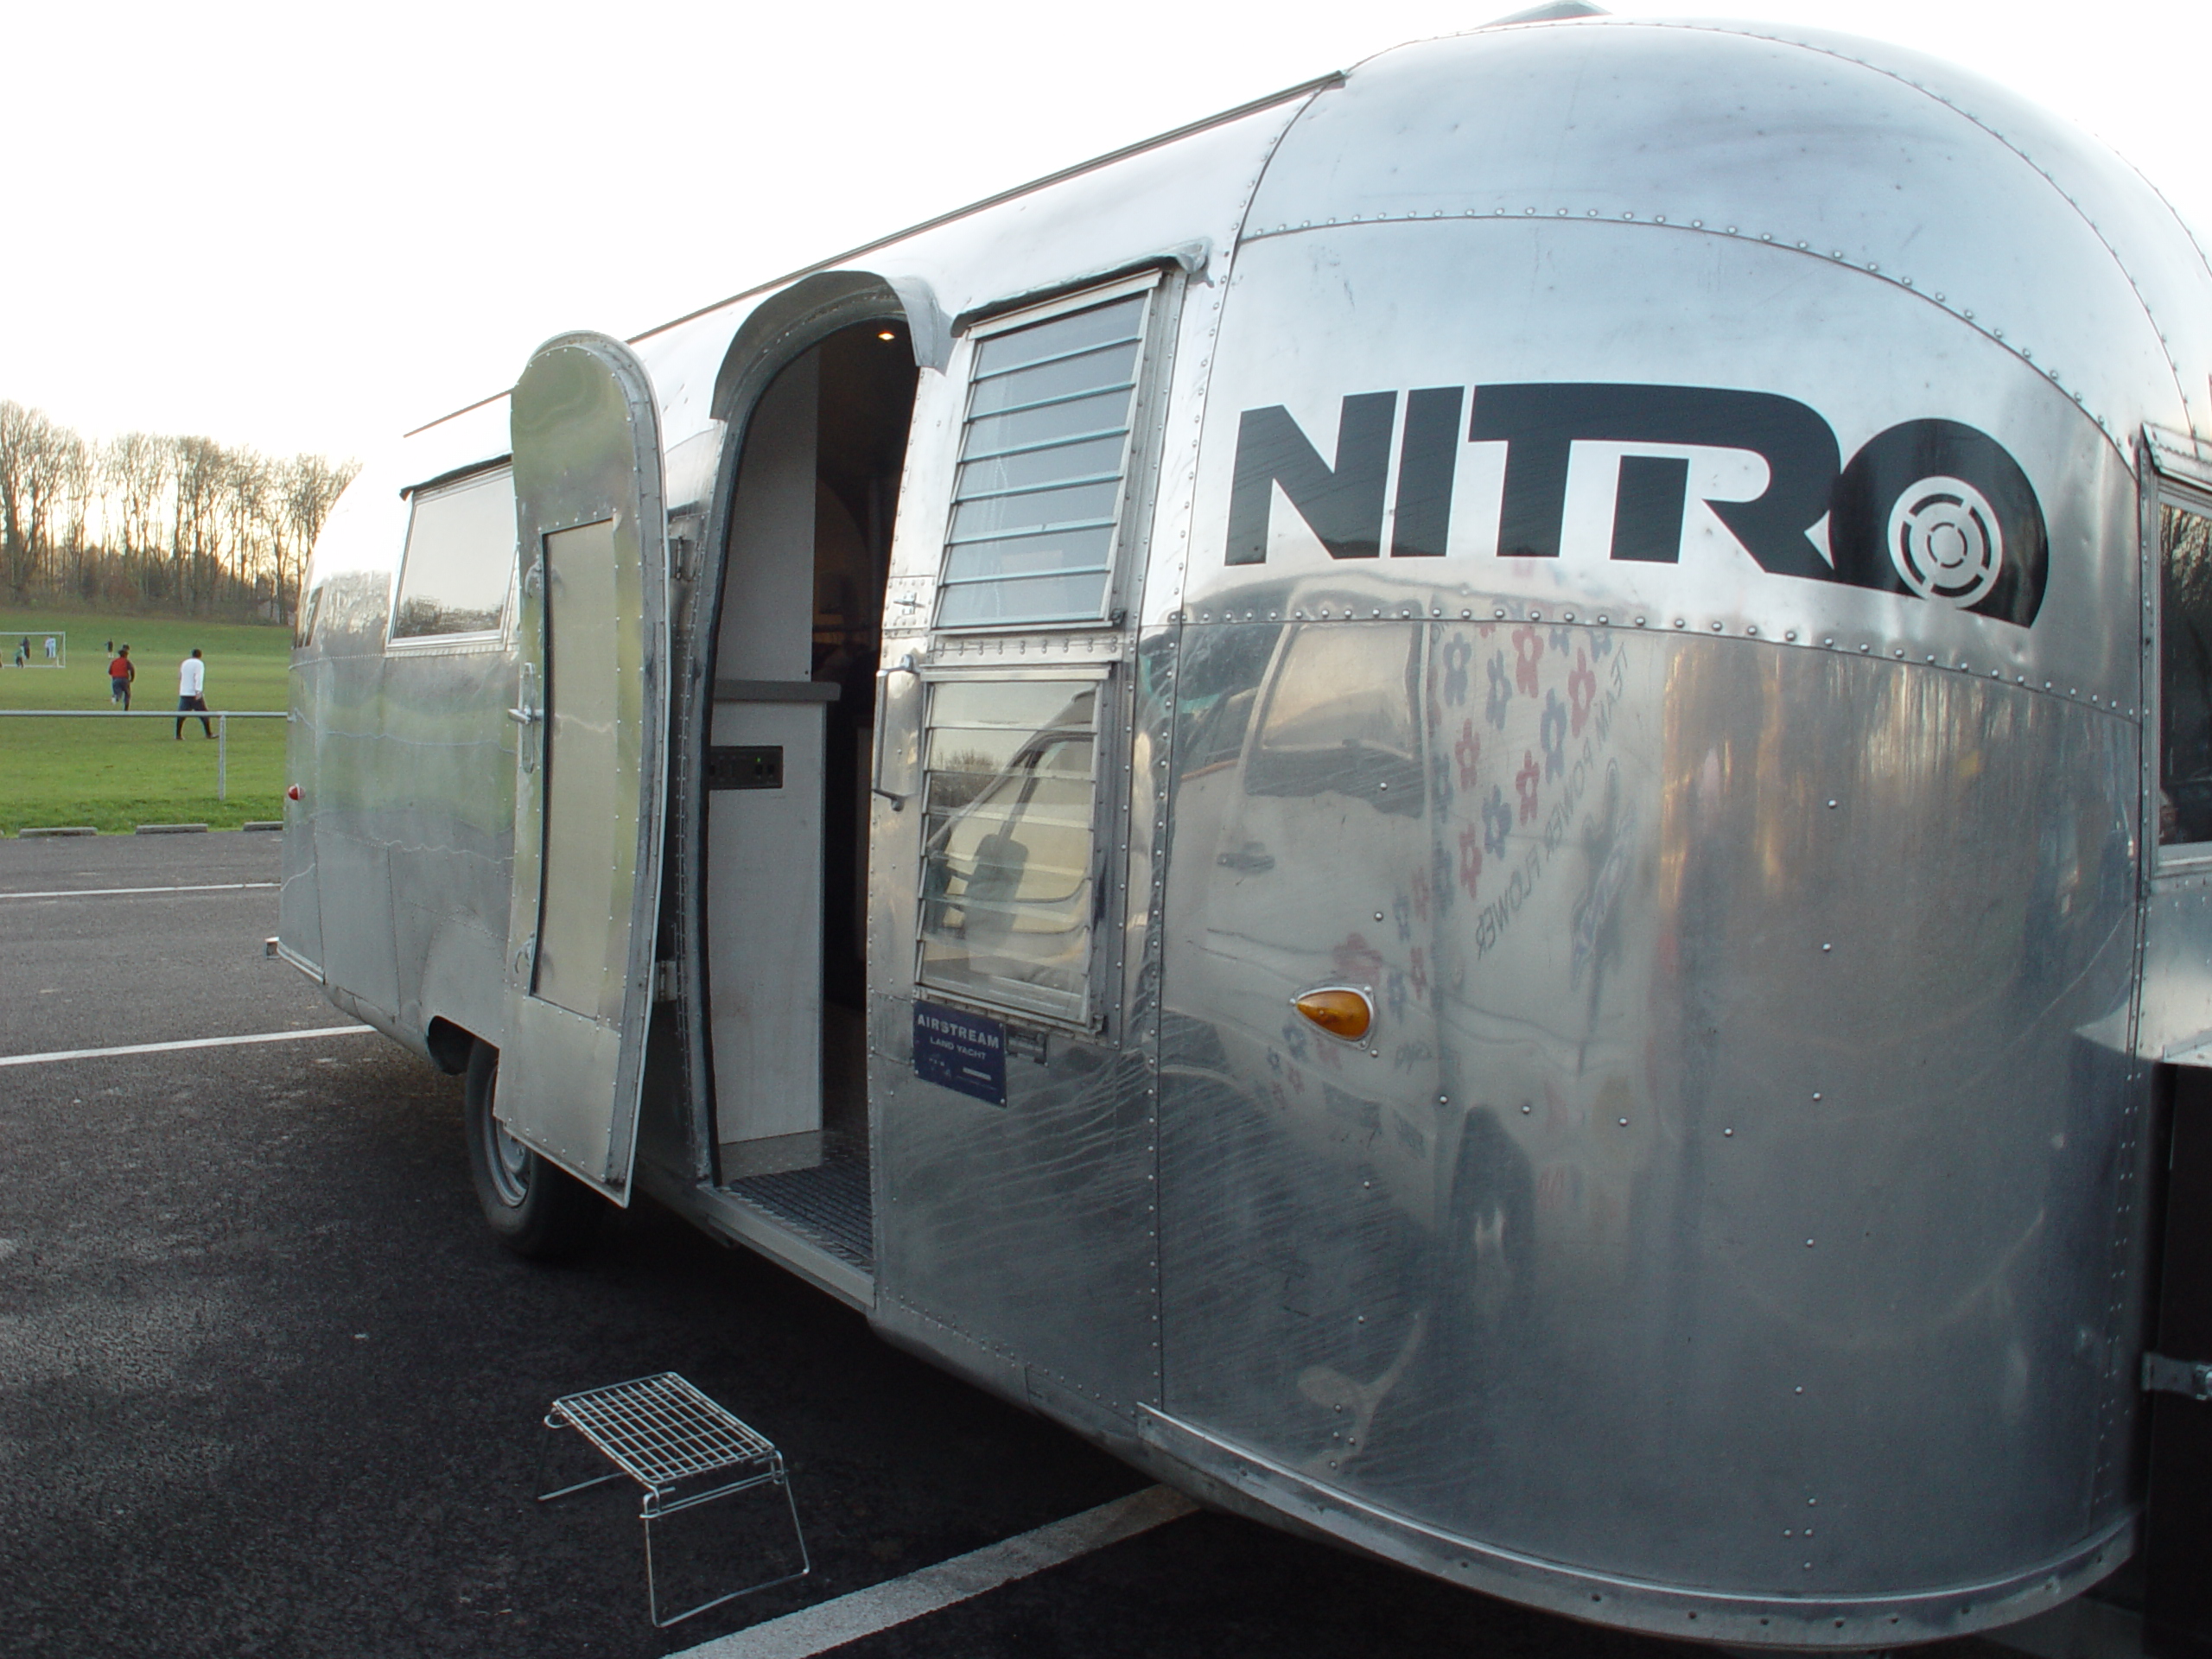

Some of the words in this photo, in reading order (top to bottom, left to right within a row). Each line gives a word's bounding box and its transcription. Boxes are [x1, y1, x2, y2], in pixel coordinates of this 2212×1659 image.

[1224, 382, 2048, 628] NITRO
[918, 1014, 999, 1048] AIRSTREAM
[930, 1037, 955, 1050] LAND
[957, 1045, 986, 1059] YACHT
